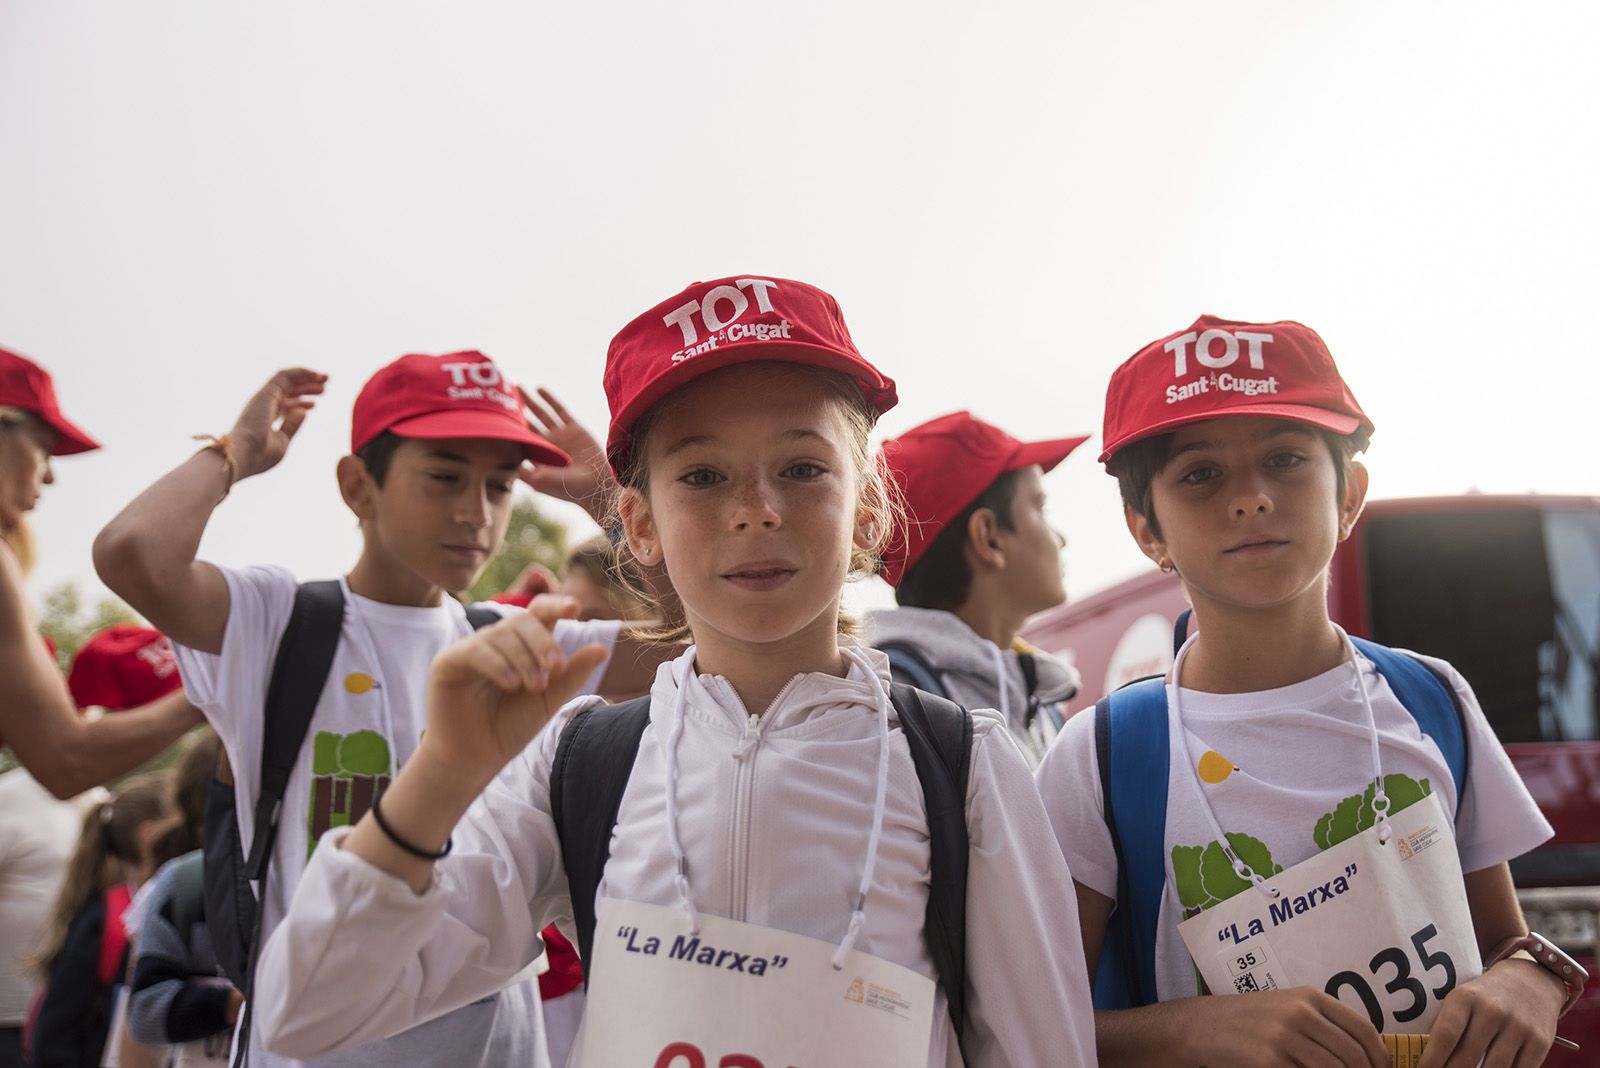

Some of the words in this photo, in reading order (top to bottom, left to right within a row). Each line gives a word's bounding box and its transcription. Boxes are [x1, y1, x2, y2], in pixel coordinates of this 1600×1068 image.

[663, 279, 777, 347] TOT
[671, 335, 719, 366] Sant
[727, 320, 791, 341] Cugat
[1164, 329, 1274, 378] TOT
[441, 362, 500, 386] TO
[1166, 376, 1209, 404] Sant
[1218, 373, 1278, 396] Cugat
[1218, 918, 1264, 945] “La
[1268, 863, 1357, 927] Marxa”
[1237, 952, 1256, 970] 35
[1324, 923, 1457, 1034] 035
